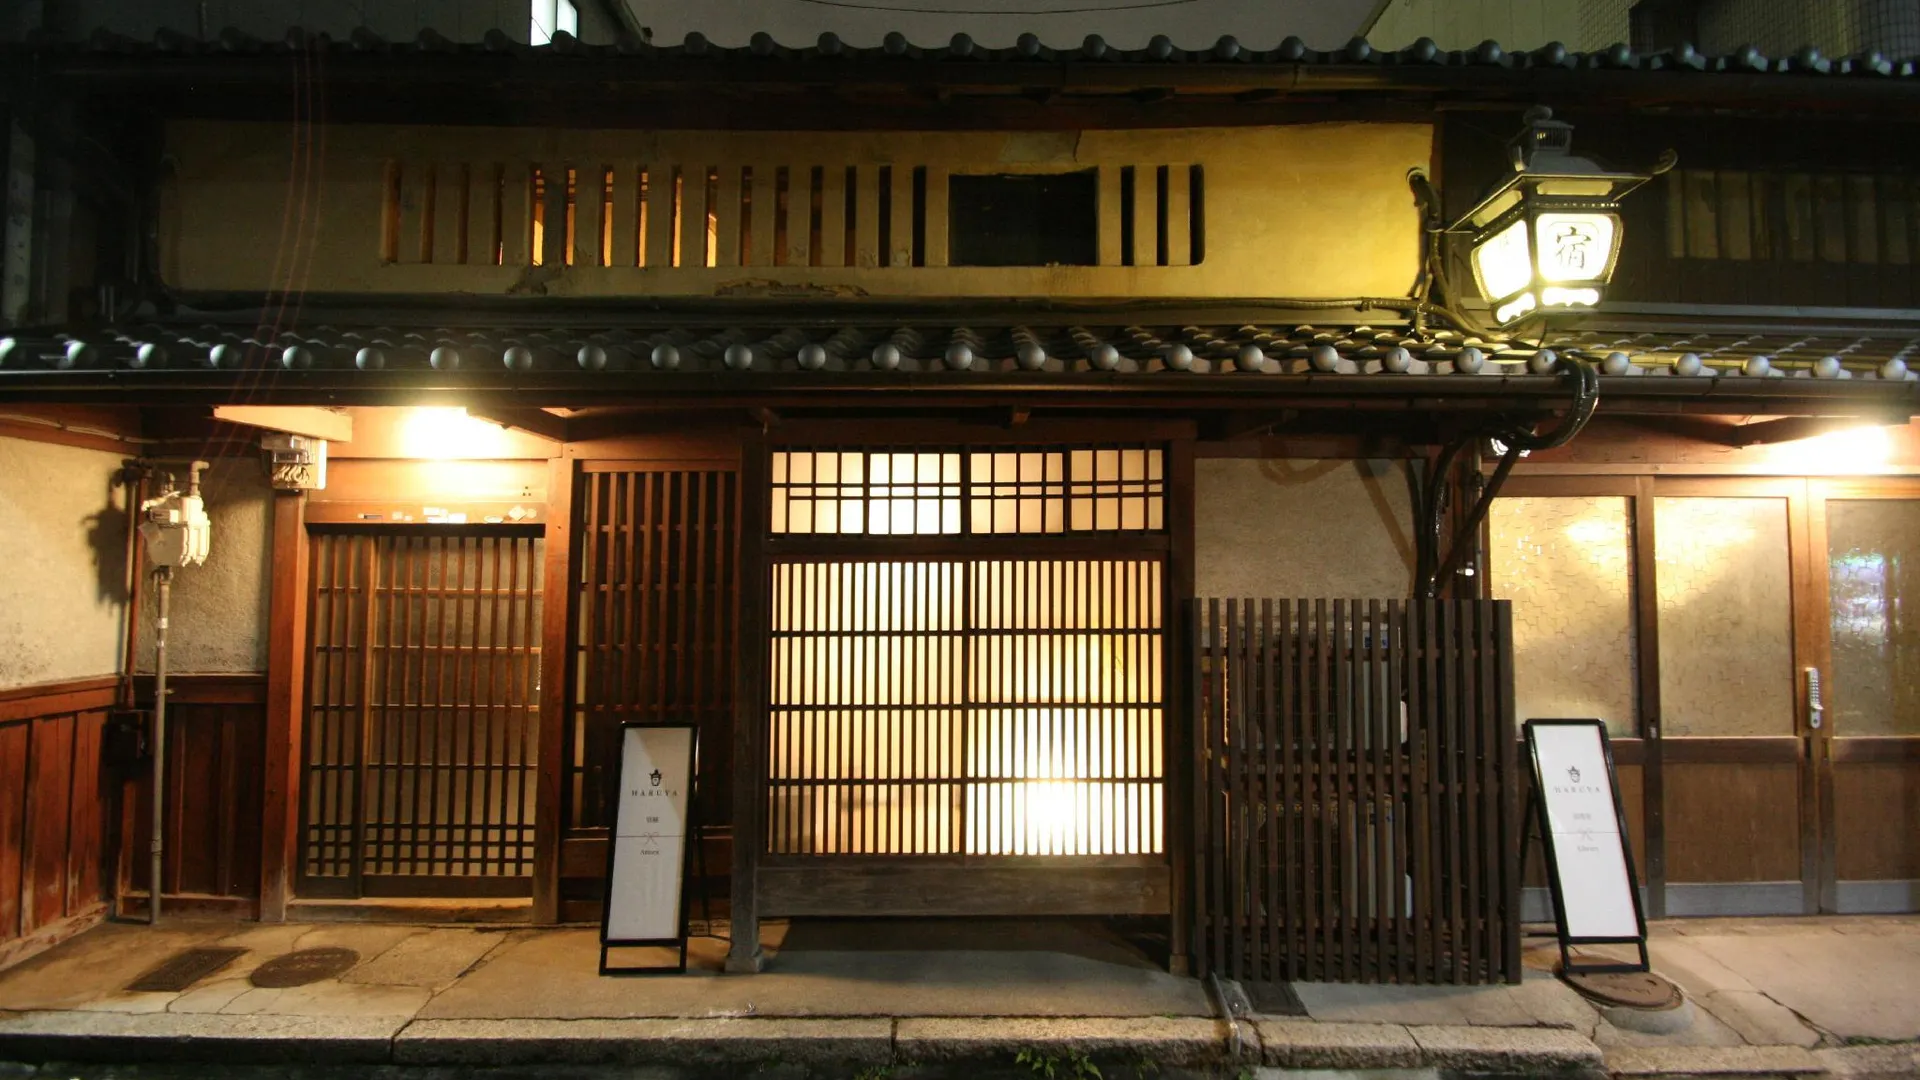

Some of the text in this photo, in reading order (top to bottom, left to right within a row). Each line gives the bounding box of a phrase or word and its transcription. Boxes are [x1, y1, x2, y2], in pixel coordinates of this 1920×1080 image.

[1555, 226, 1592, 270] 宿
[631, 789, 679, 797] HARUYA
[1554, 786, 1601, 794] HARUYA
